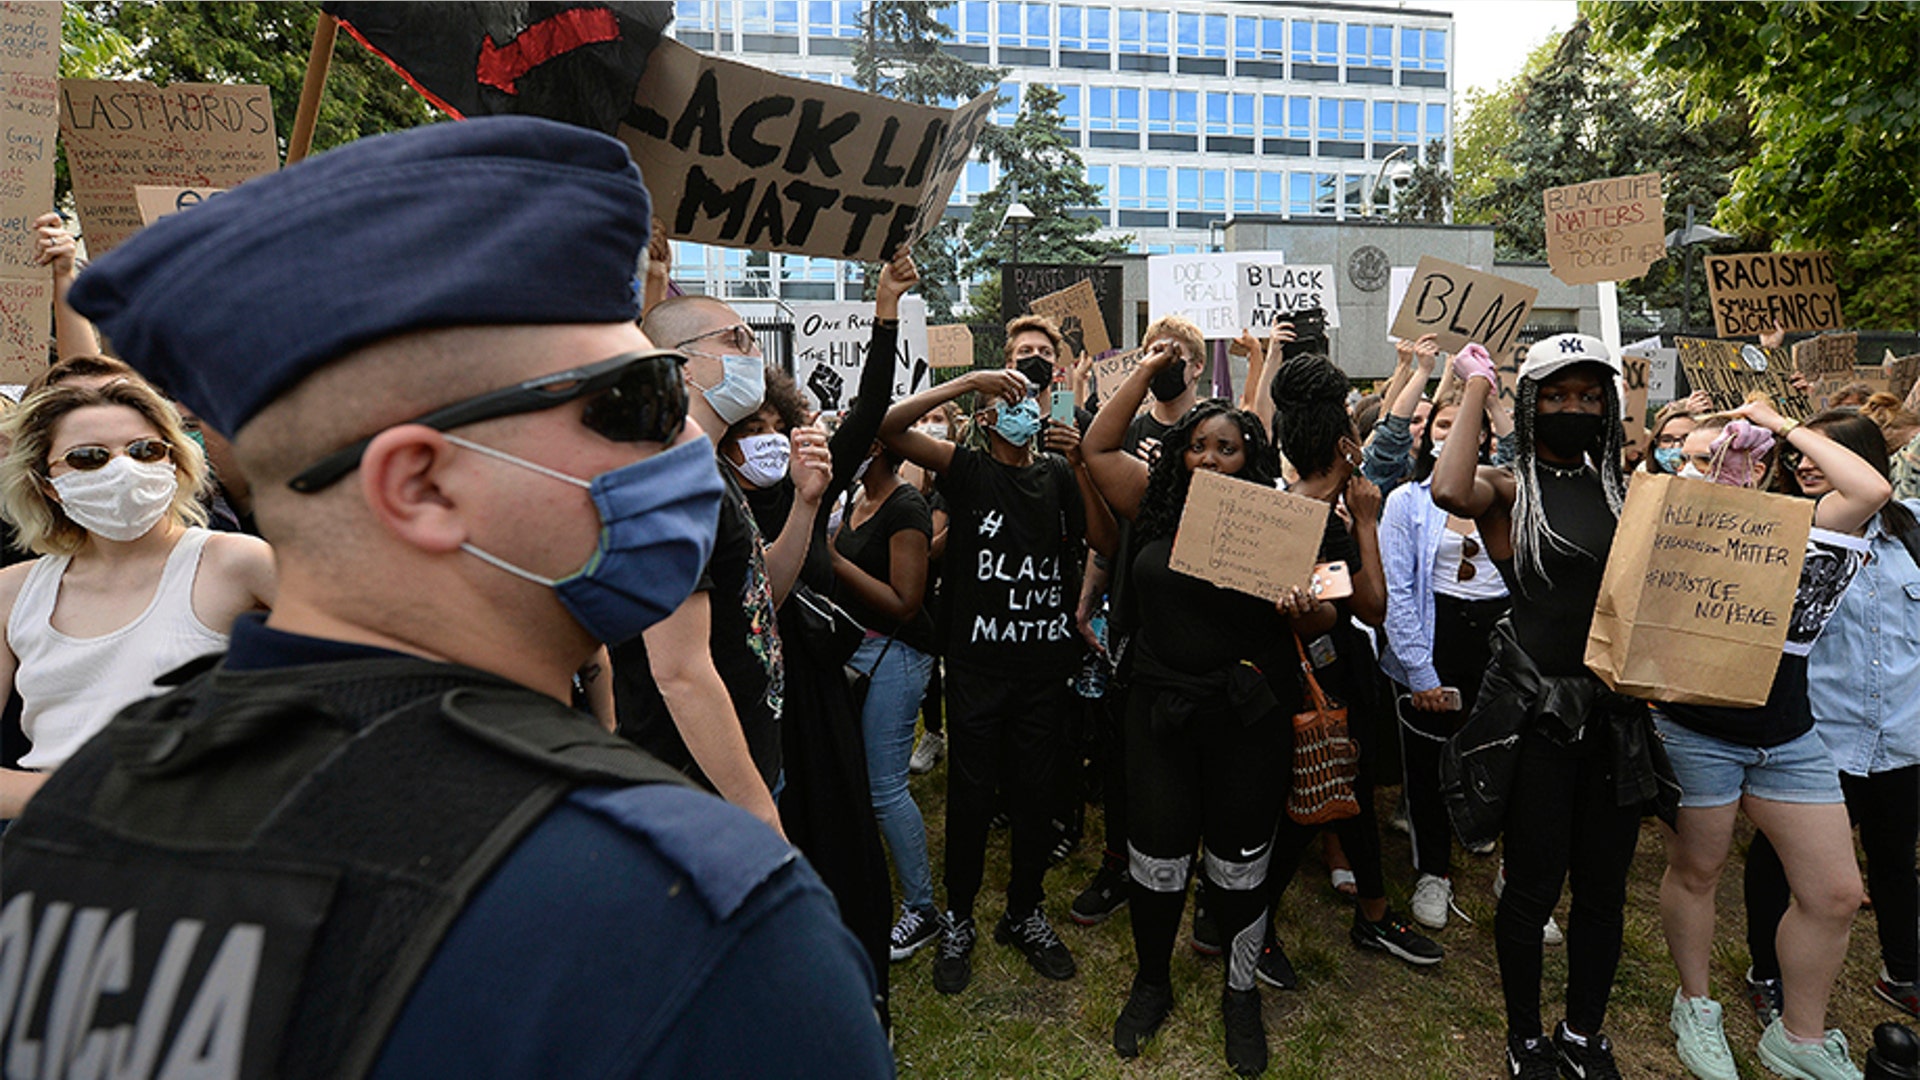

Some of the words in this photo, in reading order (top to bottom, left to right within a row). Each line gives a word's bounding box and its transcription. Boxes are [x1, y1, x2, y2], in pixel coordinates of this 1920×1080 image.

[65, 89, 147, 130] LAST
[160, 93, 268, 134] WORDS
[6, 126, 43, 160] Gray
[1616, 176, 1660, 201] LIFE
[1556, 202, 1645, 232] MATTERS
[1247, 265, 1323, 290] BLACK
[1711, 255, 1814, 291] RACISM
[1816, 255, 1834, 285] IS
[1256, 291, 1321, 310] LIVES
[1416, 273, 1526, 352] BLM
[1718, 297, 1767, 313] SMALL
[848, 313, 876, 330] RAC
[1251, 308, 1331, 328] MAR
[801, 346, 827, 362] THE
[829, 339, 909, 369] HUMN
[979, 509, 1004, 539] #
[1665, 504, 1693, 526] ALL
[1696, 511, 1740, 531] LIVES
[1725, 537, 1790, 567] MATTER
[971, 612, 1072, 643] MATTER
[1694, 600, 1724, 619] NO
[1725, 602, 1779, 627] PEACE
